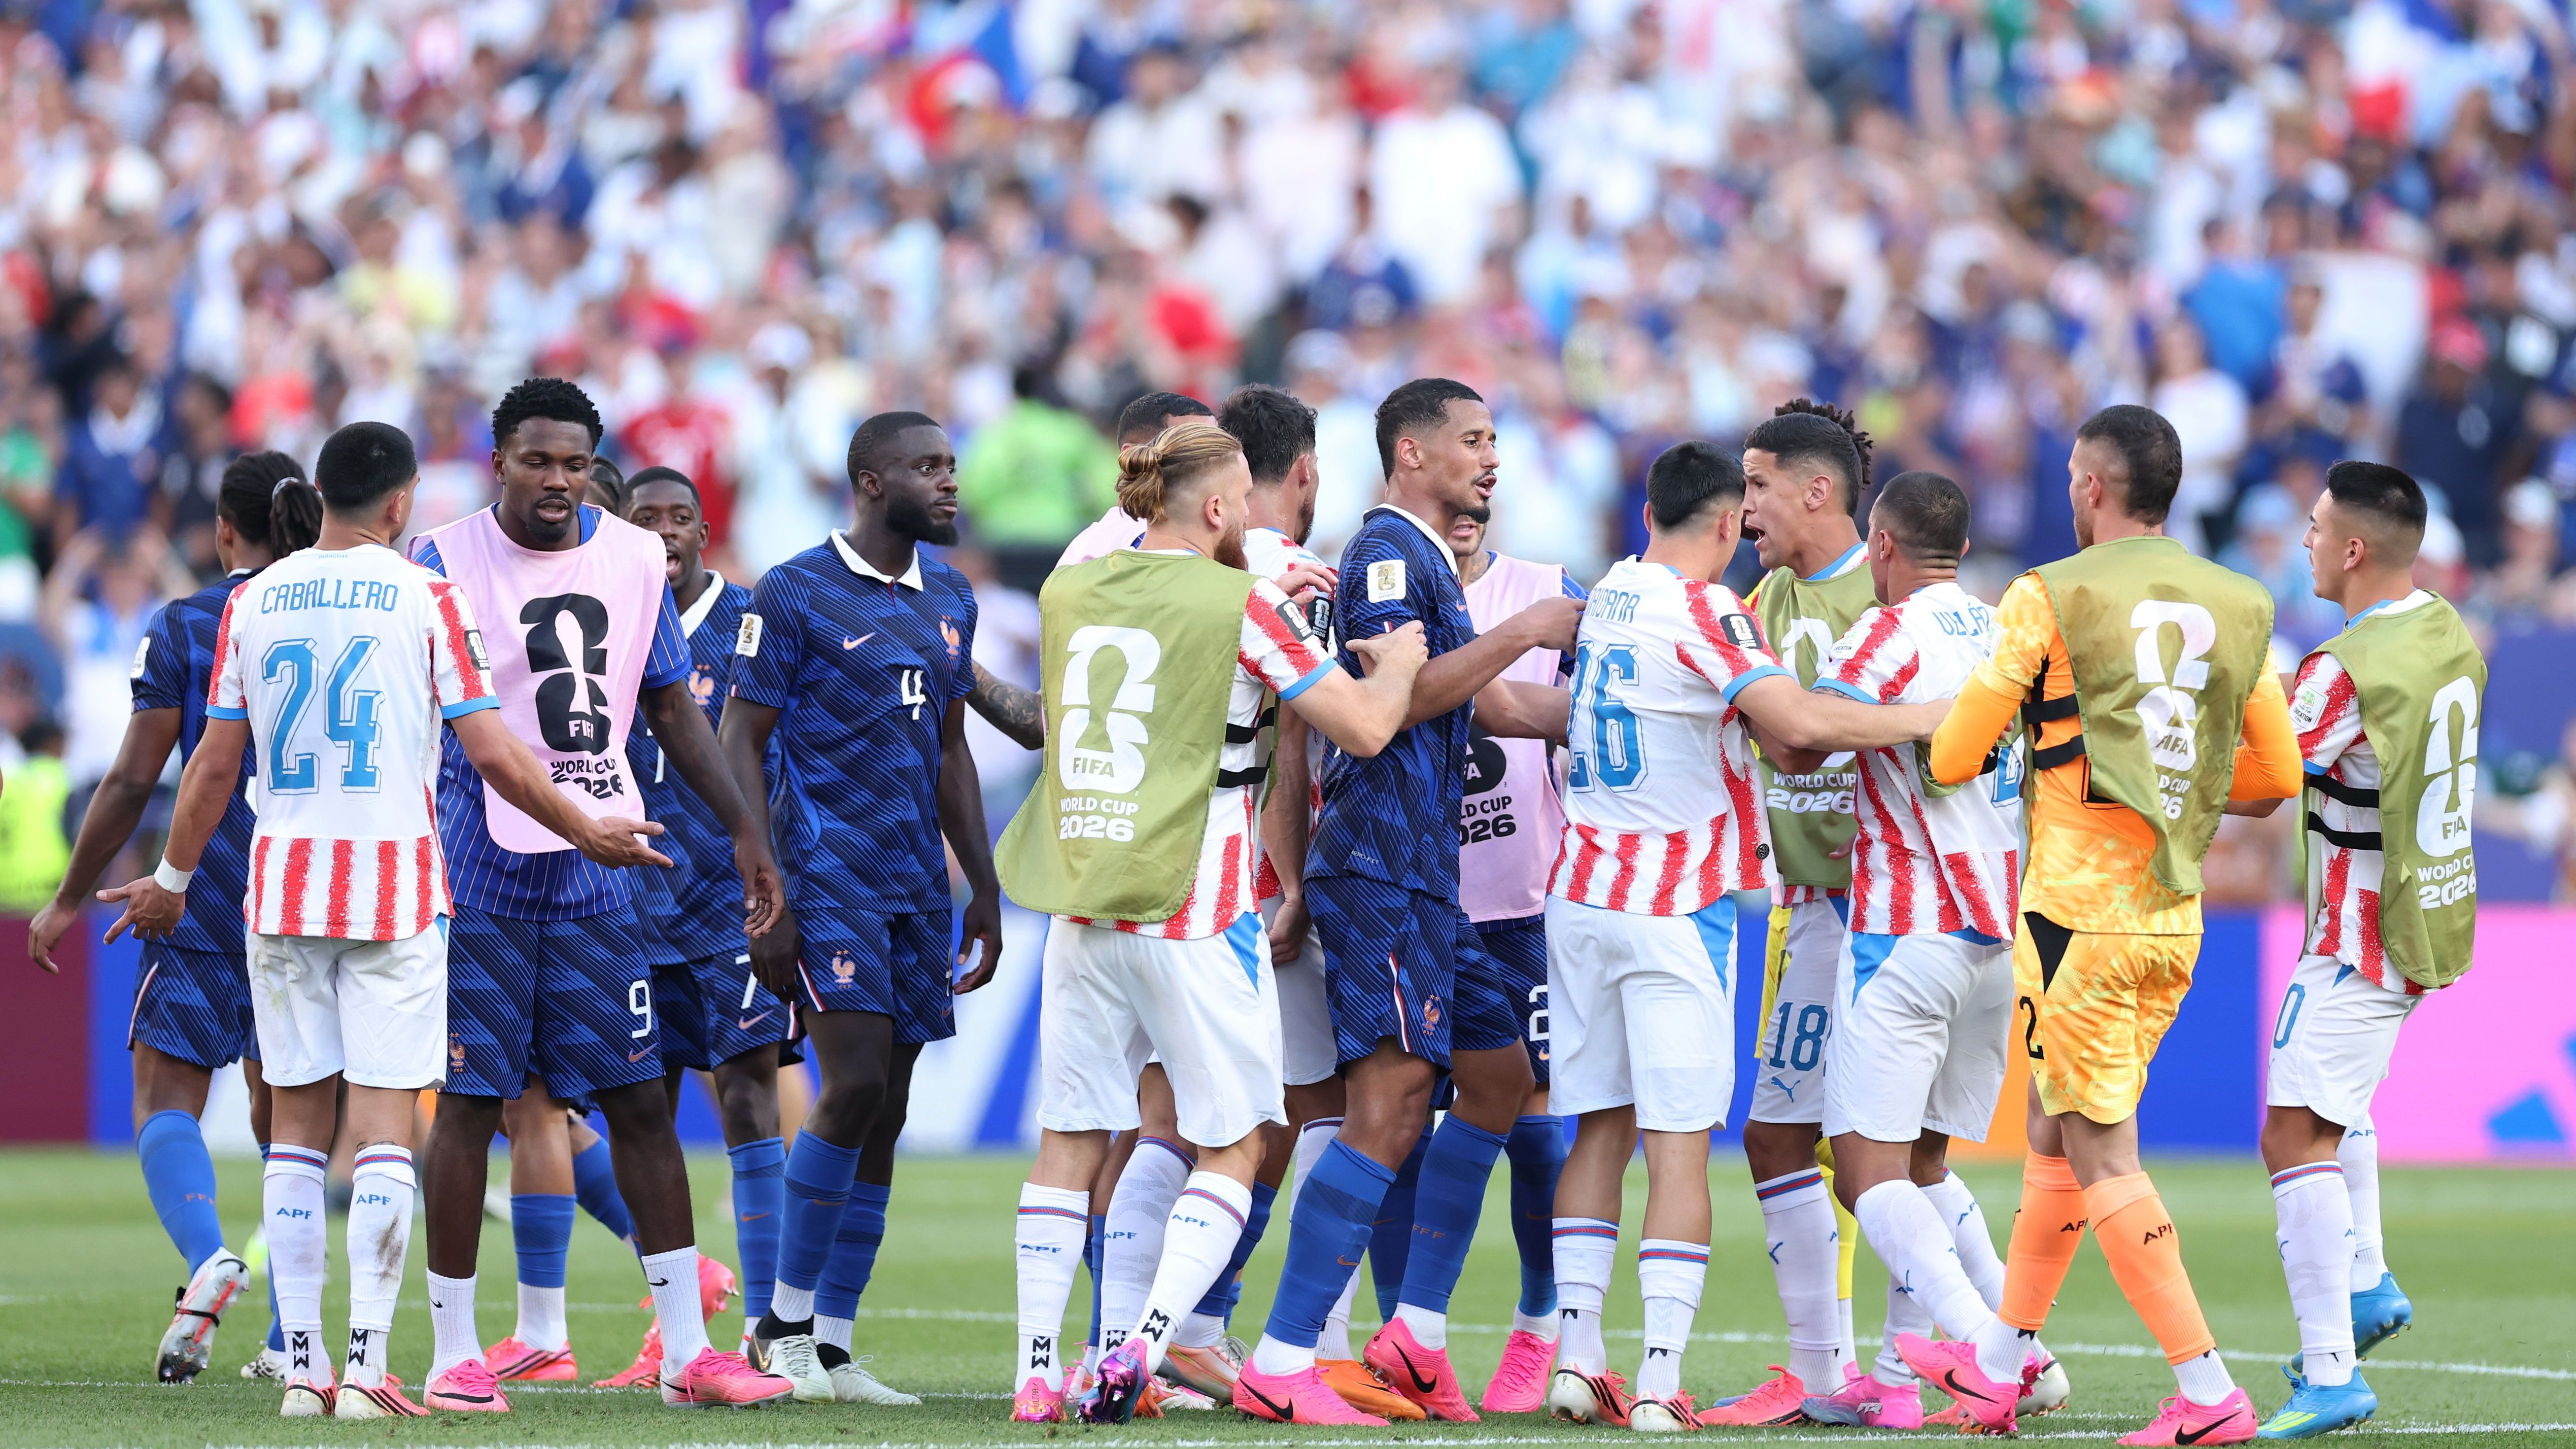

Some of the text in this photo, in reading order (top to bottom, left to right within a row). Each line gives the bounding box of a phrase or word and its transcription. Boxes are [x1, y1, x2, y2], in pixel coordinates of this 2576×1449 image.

[261, 579, 398, 612] CABALLERO
[901, 669, 926, 720] 4
[261, 636, 385, 795] 24
[1568, 639, 1649, 793] 26
[551, 760, 594, 774] WORL
[1073, 757, 1114, 778] FIFA
[1773, 772, 1857, 788] WORLD CUP
[2170, 778, 2191, 794] CUP
[1060, 797, 1139, 816] WORLD CUP
[1480, 796, 1512, 814] CUP
[1766, 788, 1854, 814] 2026
[1059, 815, 1135, 842] 2026
[2419, 870, 2477, 909] 2026
[735, 954, 759, 1009] 7
[629, 979, 652, 1039] 9
[1769, 1002, 1828, 1072] 18
[356, 1194, 391, 1205] APF
[276, 1208, 313, 1220] APF
[1171, 1214, 1211, 1228] APF
[1104, 1232, 1137, 1240] APF
[1021, 1244, 1062, 1253] APF
